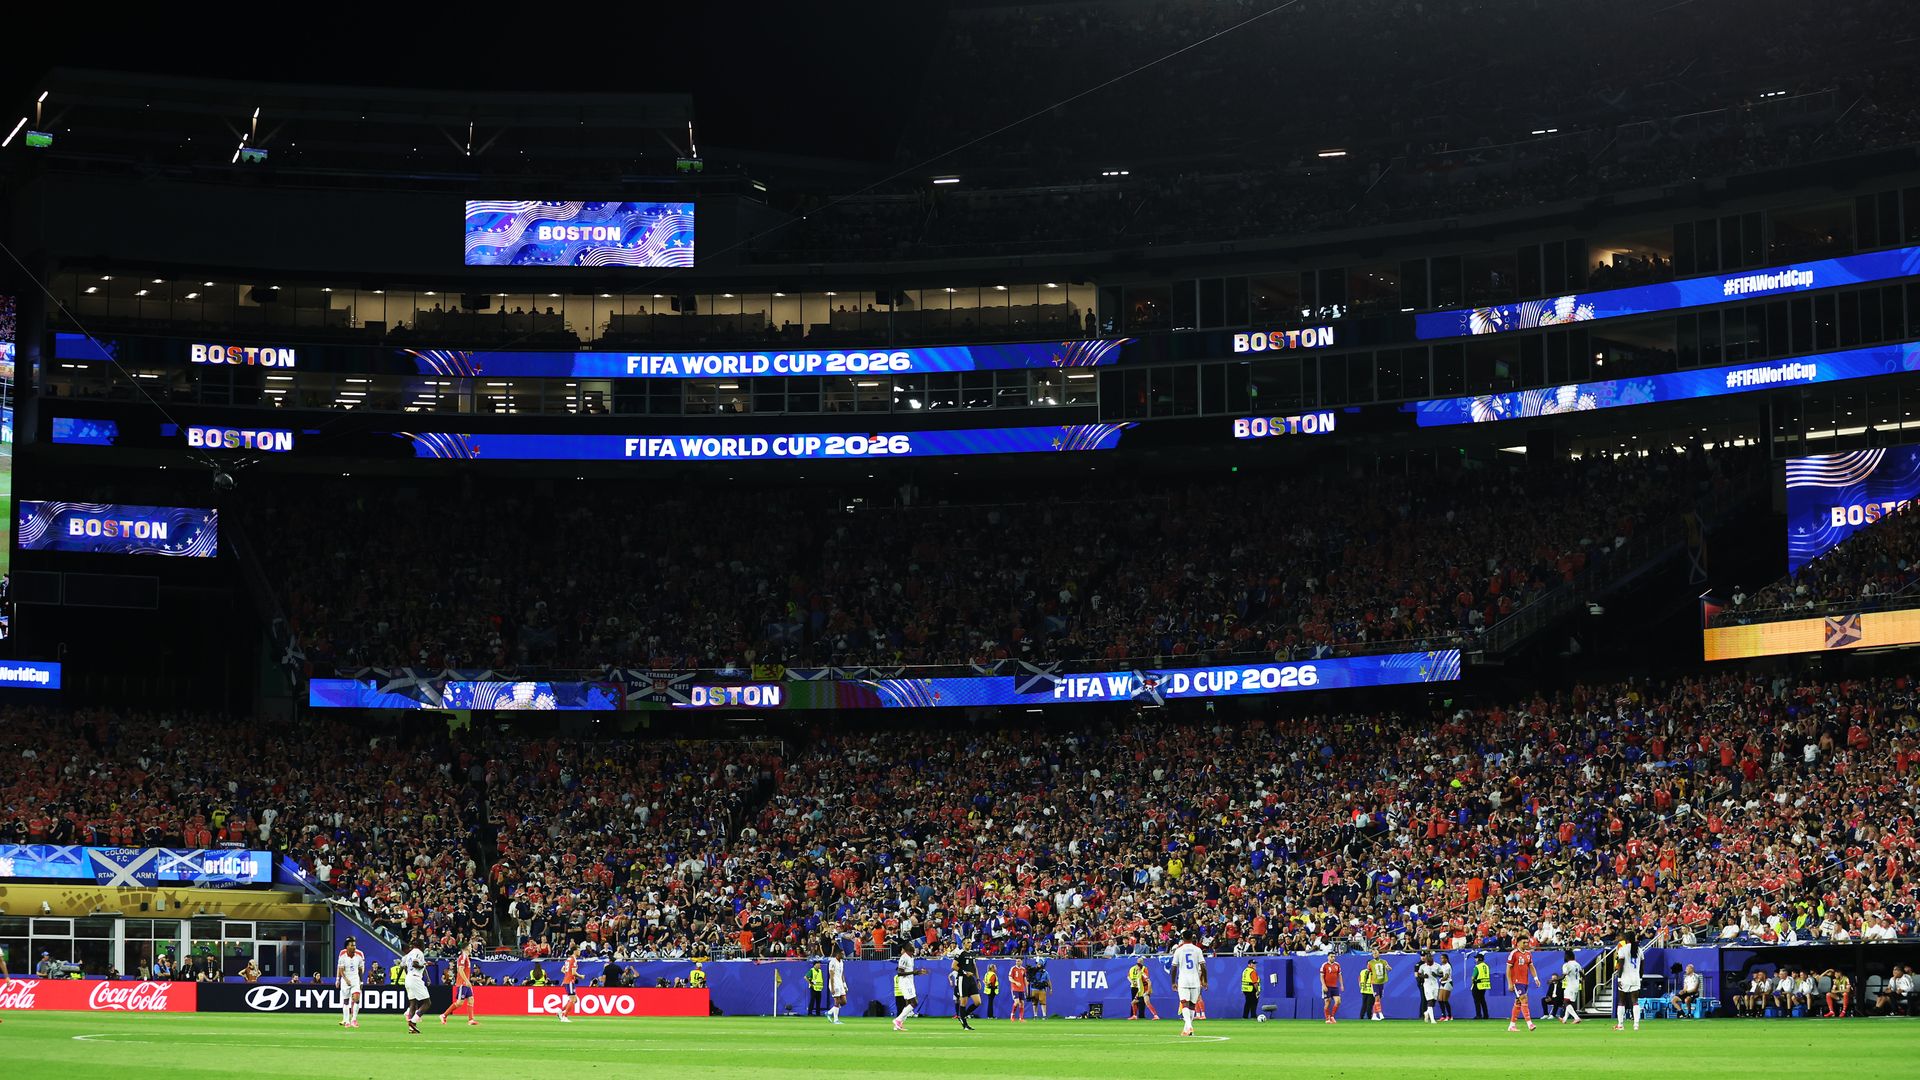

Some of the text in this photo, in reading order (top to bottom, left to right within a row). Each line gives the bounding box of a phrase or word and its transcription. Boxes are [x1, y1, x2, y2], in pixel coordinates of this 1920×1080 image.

[539, 226, 621, 242] BOSTON
[1723, 269, 1814, 296] #FIFAWorldCup
[1233, 326, 1334, 353] BOSTON
[191, 344, 296, 368] BOSTON
[627, 352, 912, 375] FIFA WORLD CUP 2026
[1726, 362, 1817, 388] #FIFAWorldCup
[1233, 412, 1335, 438] BOSTON
[187, 427, 293, 451] BOSTON
[625, 434, 910, 457] FIFA WORLD CUP 2026
[69, 518, 168, 540] BOSTON
[1053, 677, 1105, 699] FIFA
[1193, 671, 1240, 692] CUP
[1242, 664, 1318, 690] 2026
[690, 686, 780, 706] OSTON
[105, 848, 139, 857] COLOGNE
[1186, 953, 1194, 969] 5
[1070, 970, 1109, 989] FIFA
[89, 981, 173, 1011] Coca-Cola
[296, 989, 405, 1009] HYUDAI
